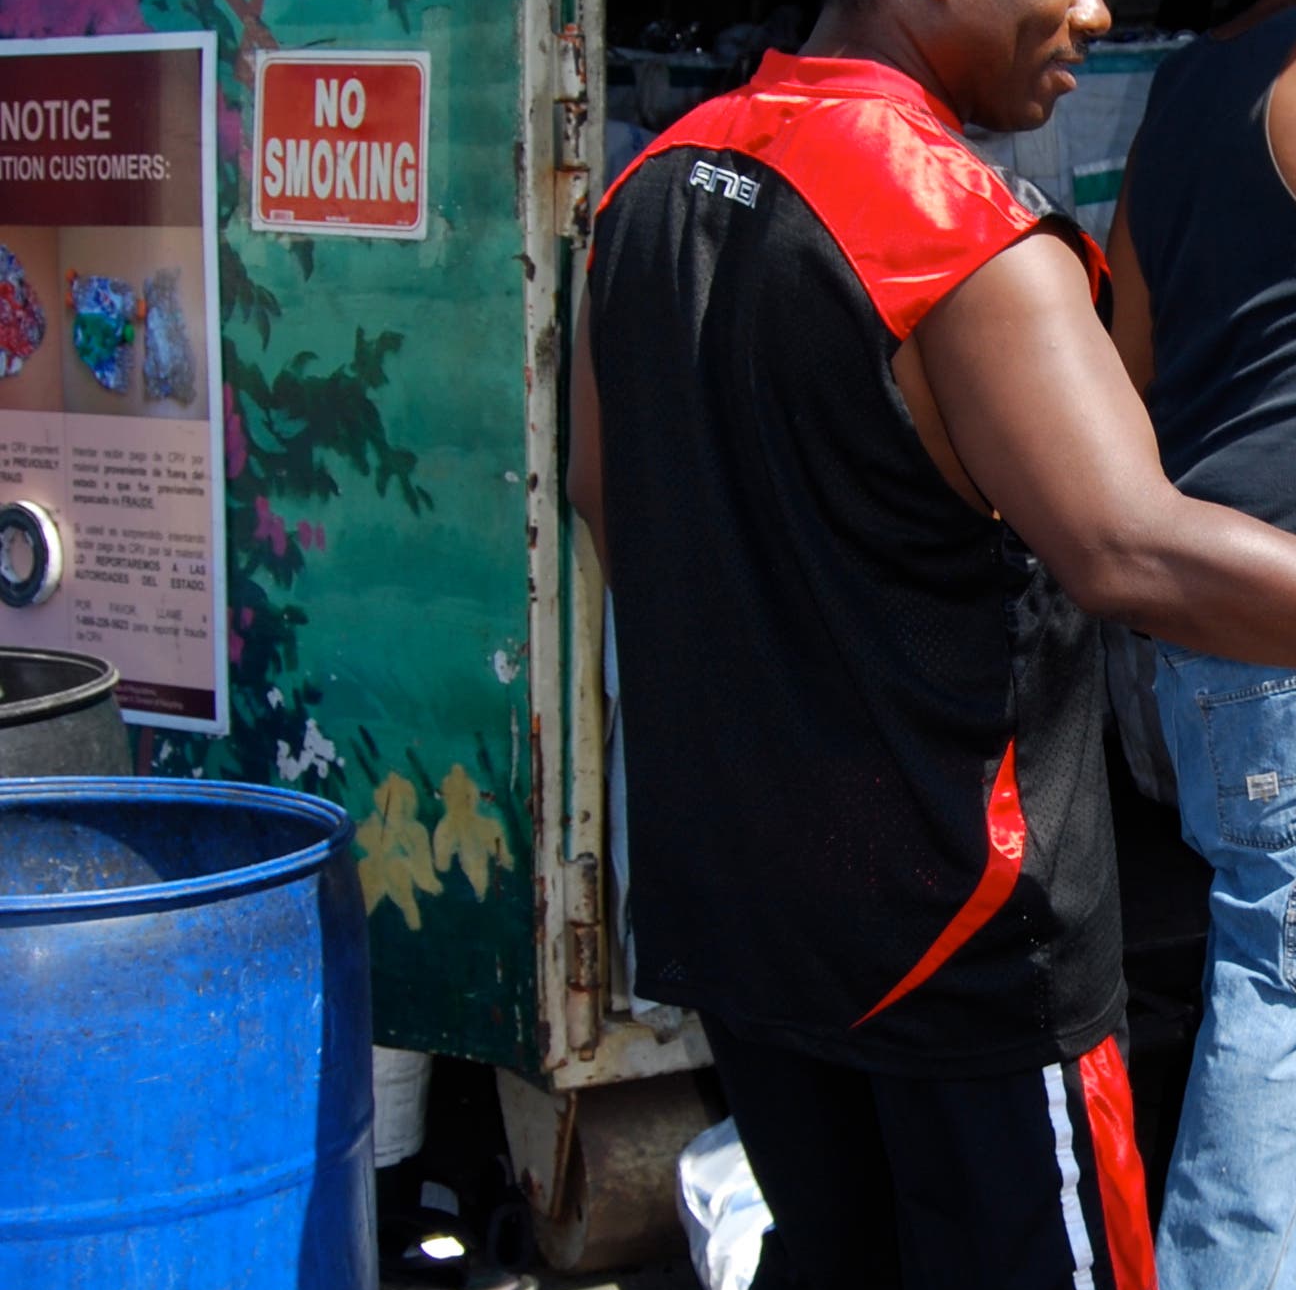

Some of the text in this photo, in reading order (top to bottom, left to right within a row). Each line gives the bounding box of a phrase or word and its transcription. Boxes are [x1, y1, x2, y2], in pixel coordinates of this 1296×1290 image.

[0, 99, 111, 141] NOTICE
[314, 77, 366, 129] NO
[49, 155, 171, 180] CUSTOMERS:
[264, 137, 416, 203] SMOKING
